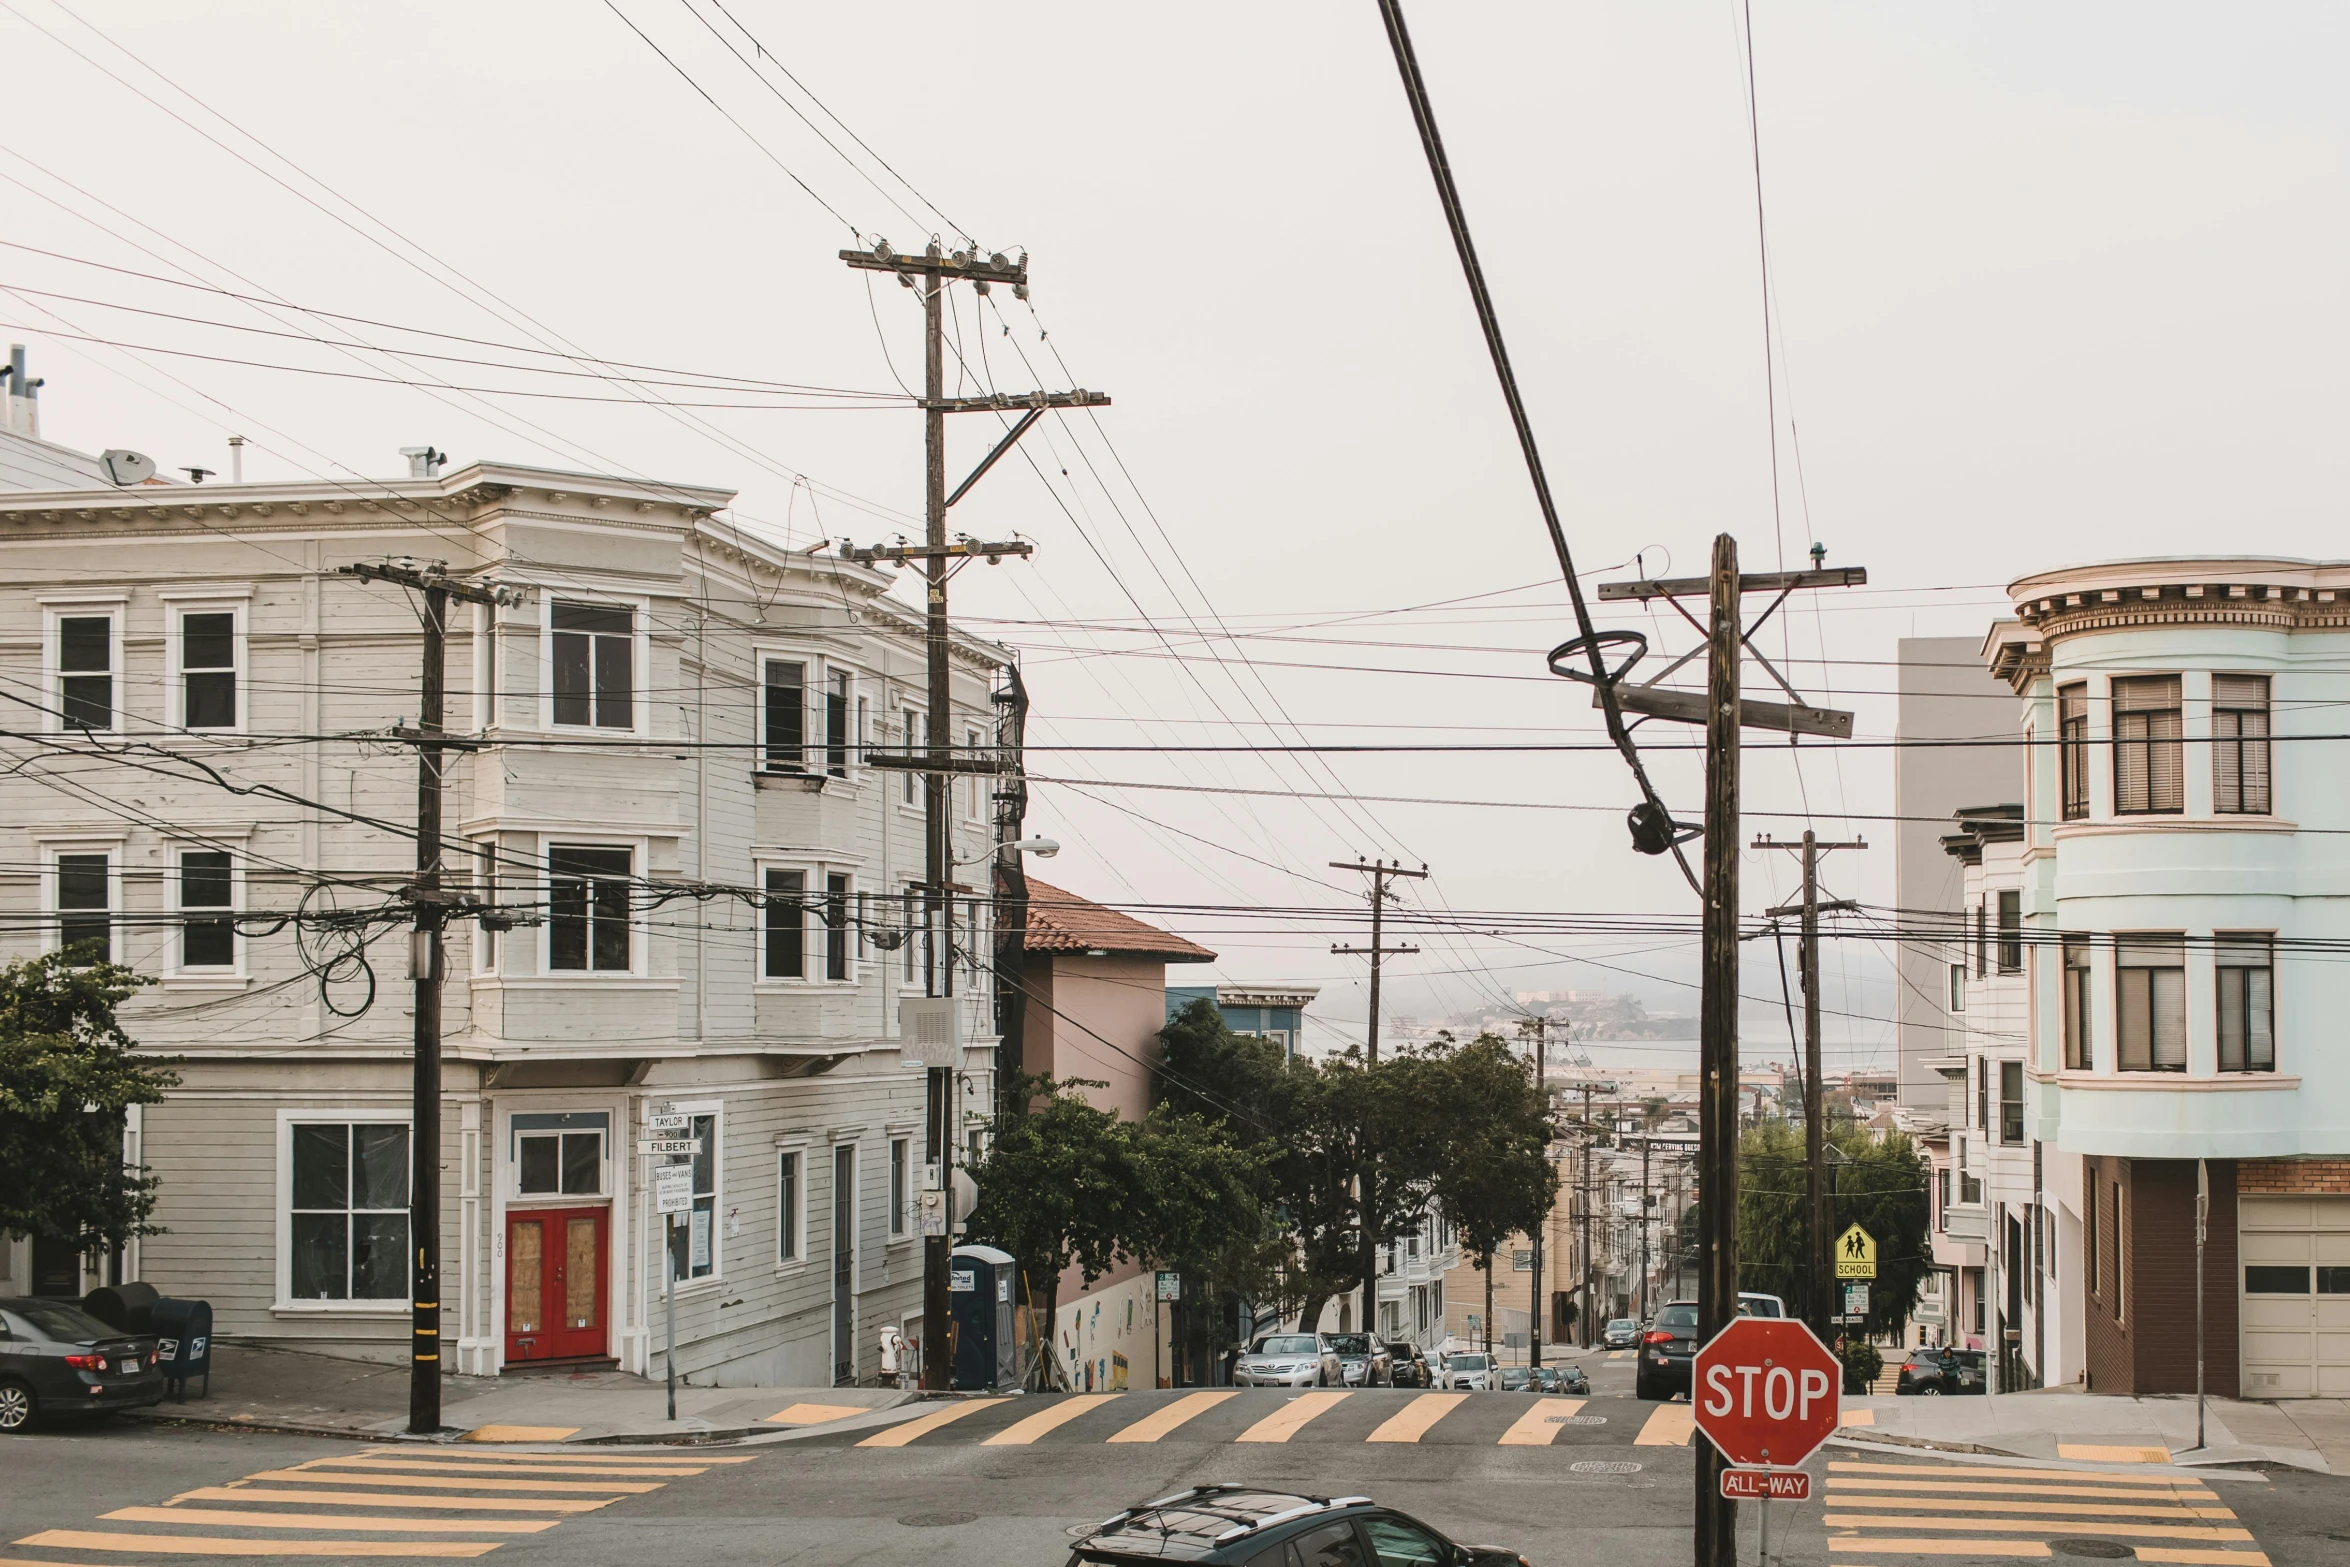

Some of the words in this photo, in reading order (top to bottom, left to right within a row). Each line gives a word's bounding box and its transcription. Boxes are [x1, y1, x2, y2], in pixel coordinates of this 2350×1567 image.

[655, 1116, 683, 1127] TAYLOR
[651, 1141, 692, 1152] FILBERT
[656, 1171, 671, 1180] BUSES
[678, 1169, 691, 1178] VANS
[662, 1196, 688, 1208] PROHIBITED
[1838, 1264, 1873, 1274] SCHOOL
[1704, 1364, 1829, 1420] STOP
[1726, 1475, 1806, 1495] ALL-WAY
